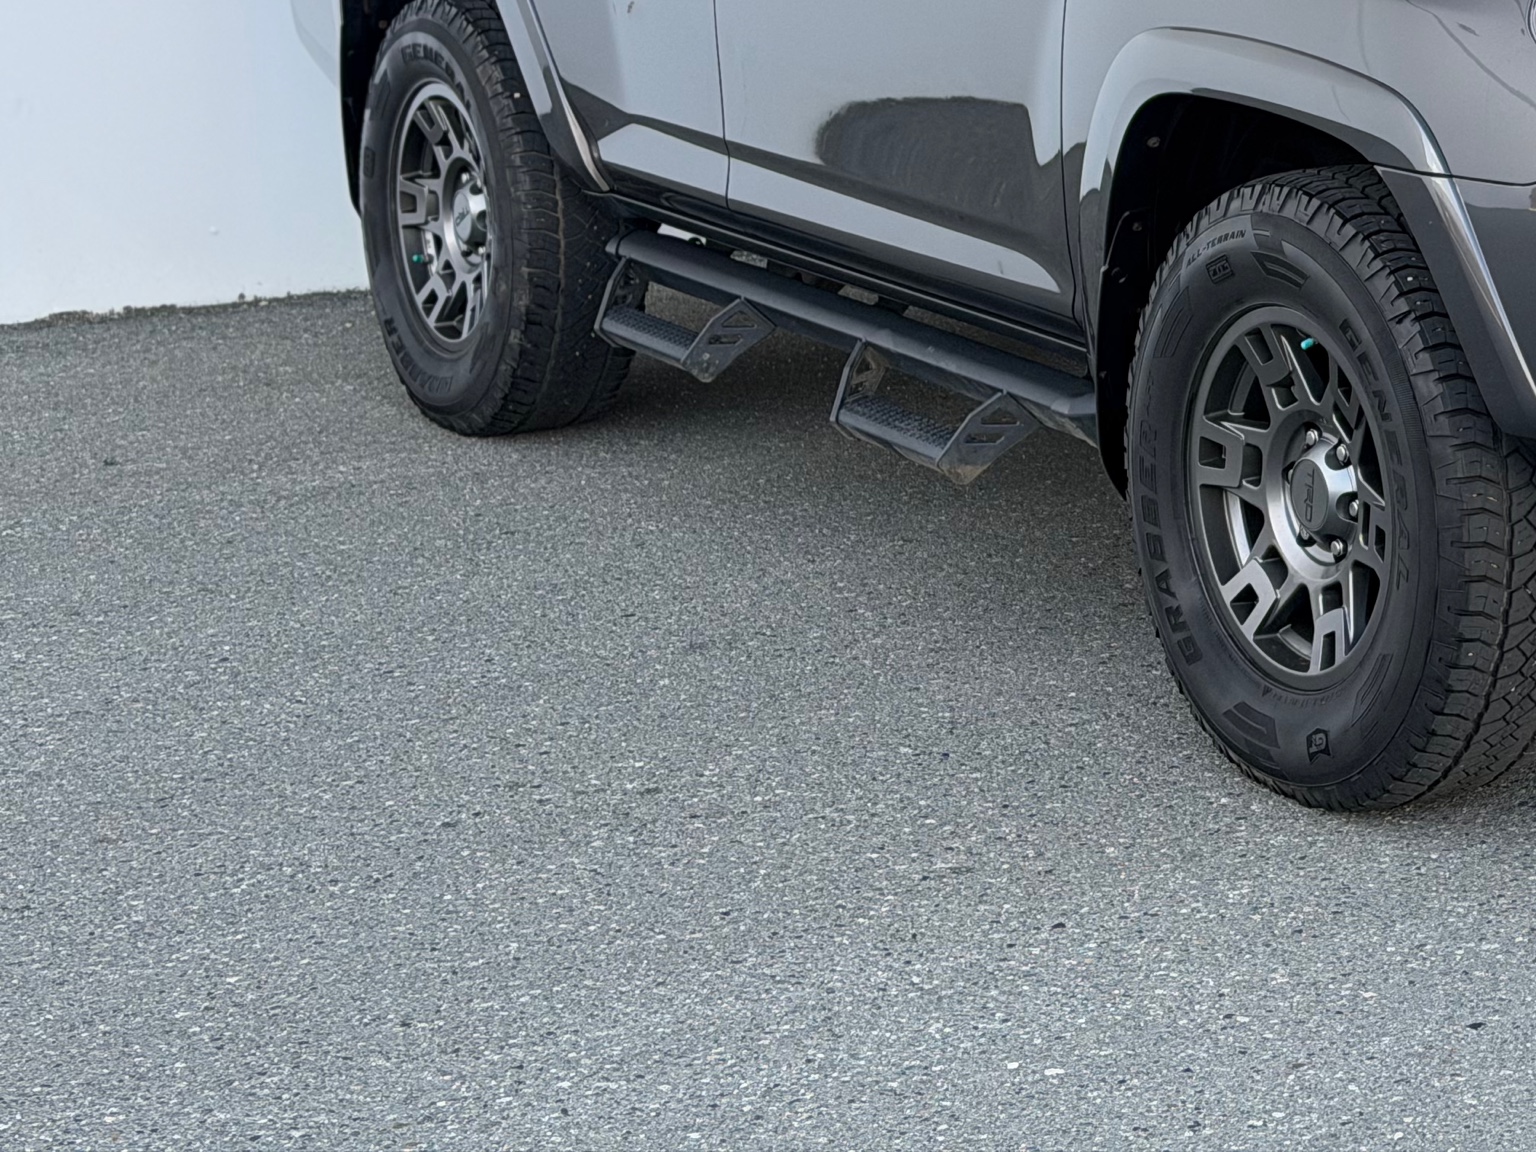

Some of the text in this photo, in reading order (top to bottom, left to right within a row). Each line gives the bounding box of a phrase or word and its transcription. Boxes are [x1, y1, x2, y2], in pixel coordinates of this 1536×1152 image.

[1186, 229, 1247, 268] ALL-TERRAIN
[1303, 468, 1316, 523] TRD
[1339, 317, 1410, 591] GENERAL
[1139, 419, 1204, 667] GRABBER
